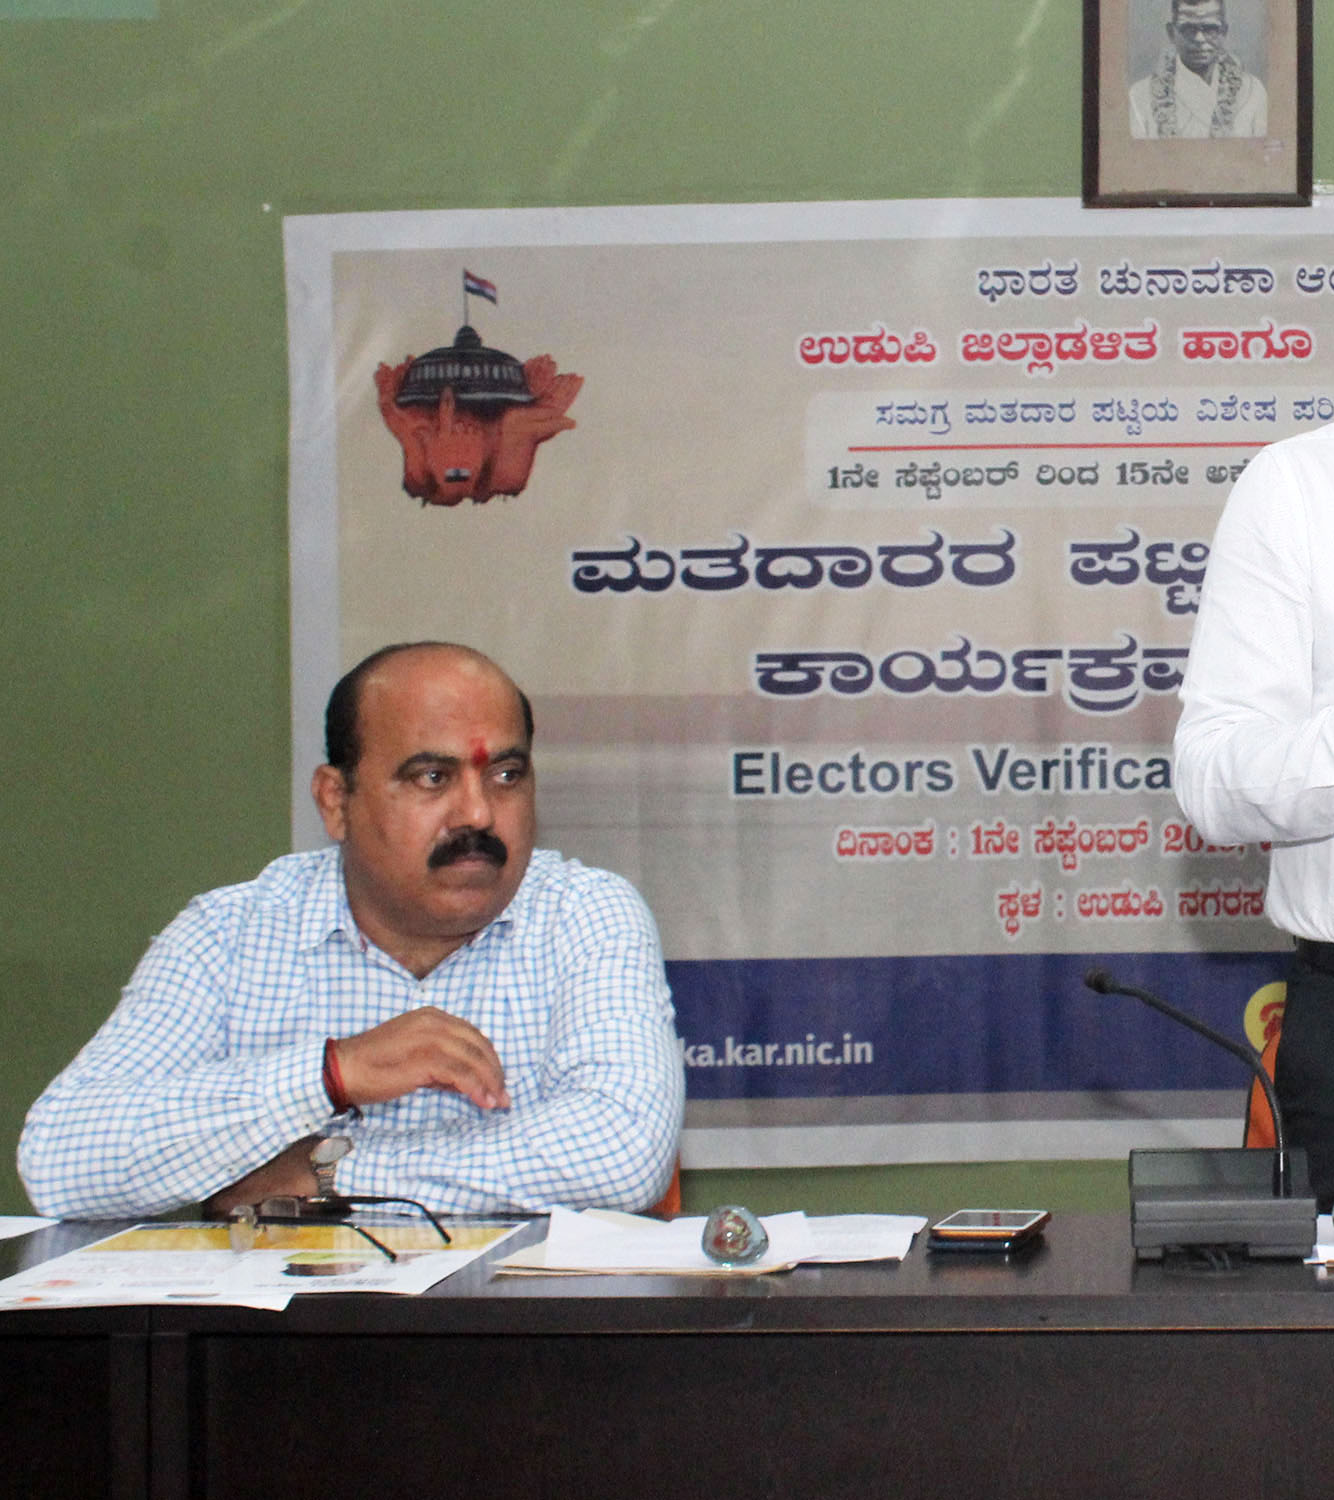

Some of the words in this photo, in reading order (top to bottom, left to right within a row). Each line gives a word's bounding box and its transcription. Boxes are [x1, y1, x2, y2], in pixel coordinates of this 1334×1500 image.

[978, 264, 1078, 301] ಭಾರತ
[1100, 264, 1274, 297] ಚುನಾವಣಾ
[801, 326, 937, 364] ಉಡುಪಿ
[961, 324, 1157, 373] ಜಿಲ್ಲಾಡಳಿತ
[1183, 324, 1312, 360] ಹಾಗೂ
[876, 401, 951, 435] ಸಮಗ್ರ
[965, 398, 1075, 424] ಮತದಾರ
[1093, 398, 1178, 435] ಪಟ್ಟಿಯ
[1197, 395, 1277, 422] ವಿಶೇಷ
[896, 461, 1019, 499] ಸೆಪ್ಟೆಂಬರ್
[1036, 463, 1098, 487] ರಿಂದ
[572, 529, 1015, 593] ಮತದಾರರ
[734, 752, 953, 795] Electors
[973, 749, 1171, 791] Verifica
[836, 829, 934, 858] ದಿನಾಂಕ
[1035, 821, 1148, 869] ಸೆಪ್ಟೆಂಬರ್
[998, 890, 1041, 935] ಸ್ಥಳ
[1077, 891, 1163, 916] ಉಡುಪಿ
[1179, 888, 1264, 916] ನಗರಸ
[677, 1033, 873, 1066] ka.kar.nic.in
